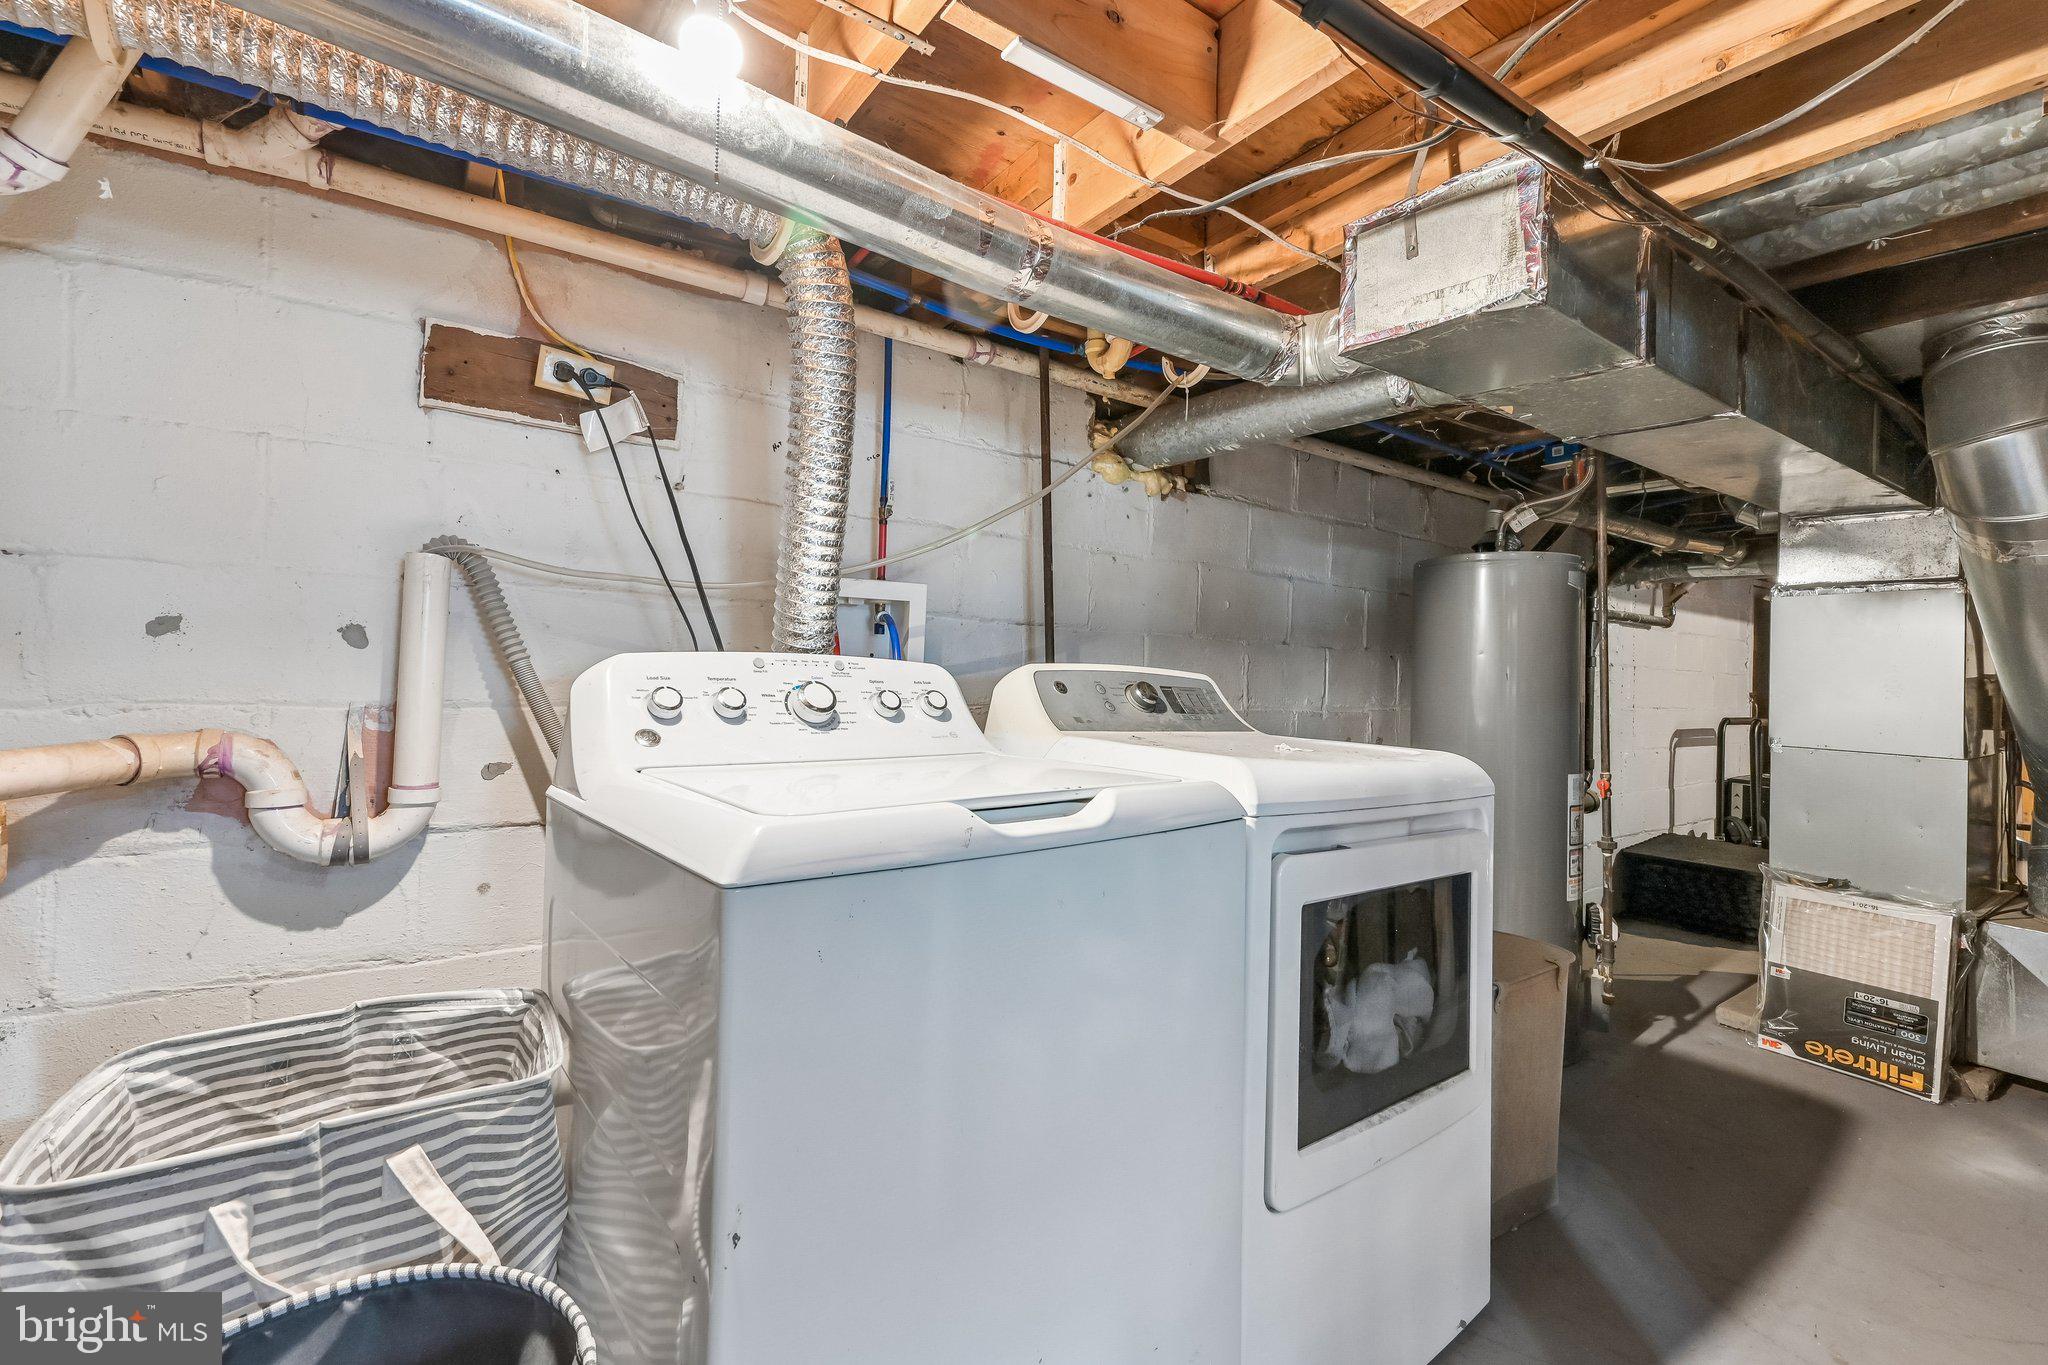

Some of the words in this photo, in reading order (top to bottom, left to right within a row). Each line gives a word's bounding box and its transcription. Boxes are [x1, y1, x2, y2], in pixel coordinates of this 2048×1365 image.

[1761, 1038, 1782, 1049] 3M
[1901, 1030, 1921, 1042] 300
[1851, 1036, 1888, 1055] Living
[1804, 1039, 1925, 1092] Filtrete
[1891, 1048, 1926, 1066] Clean
